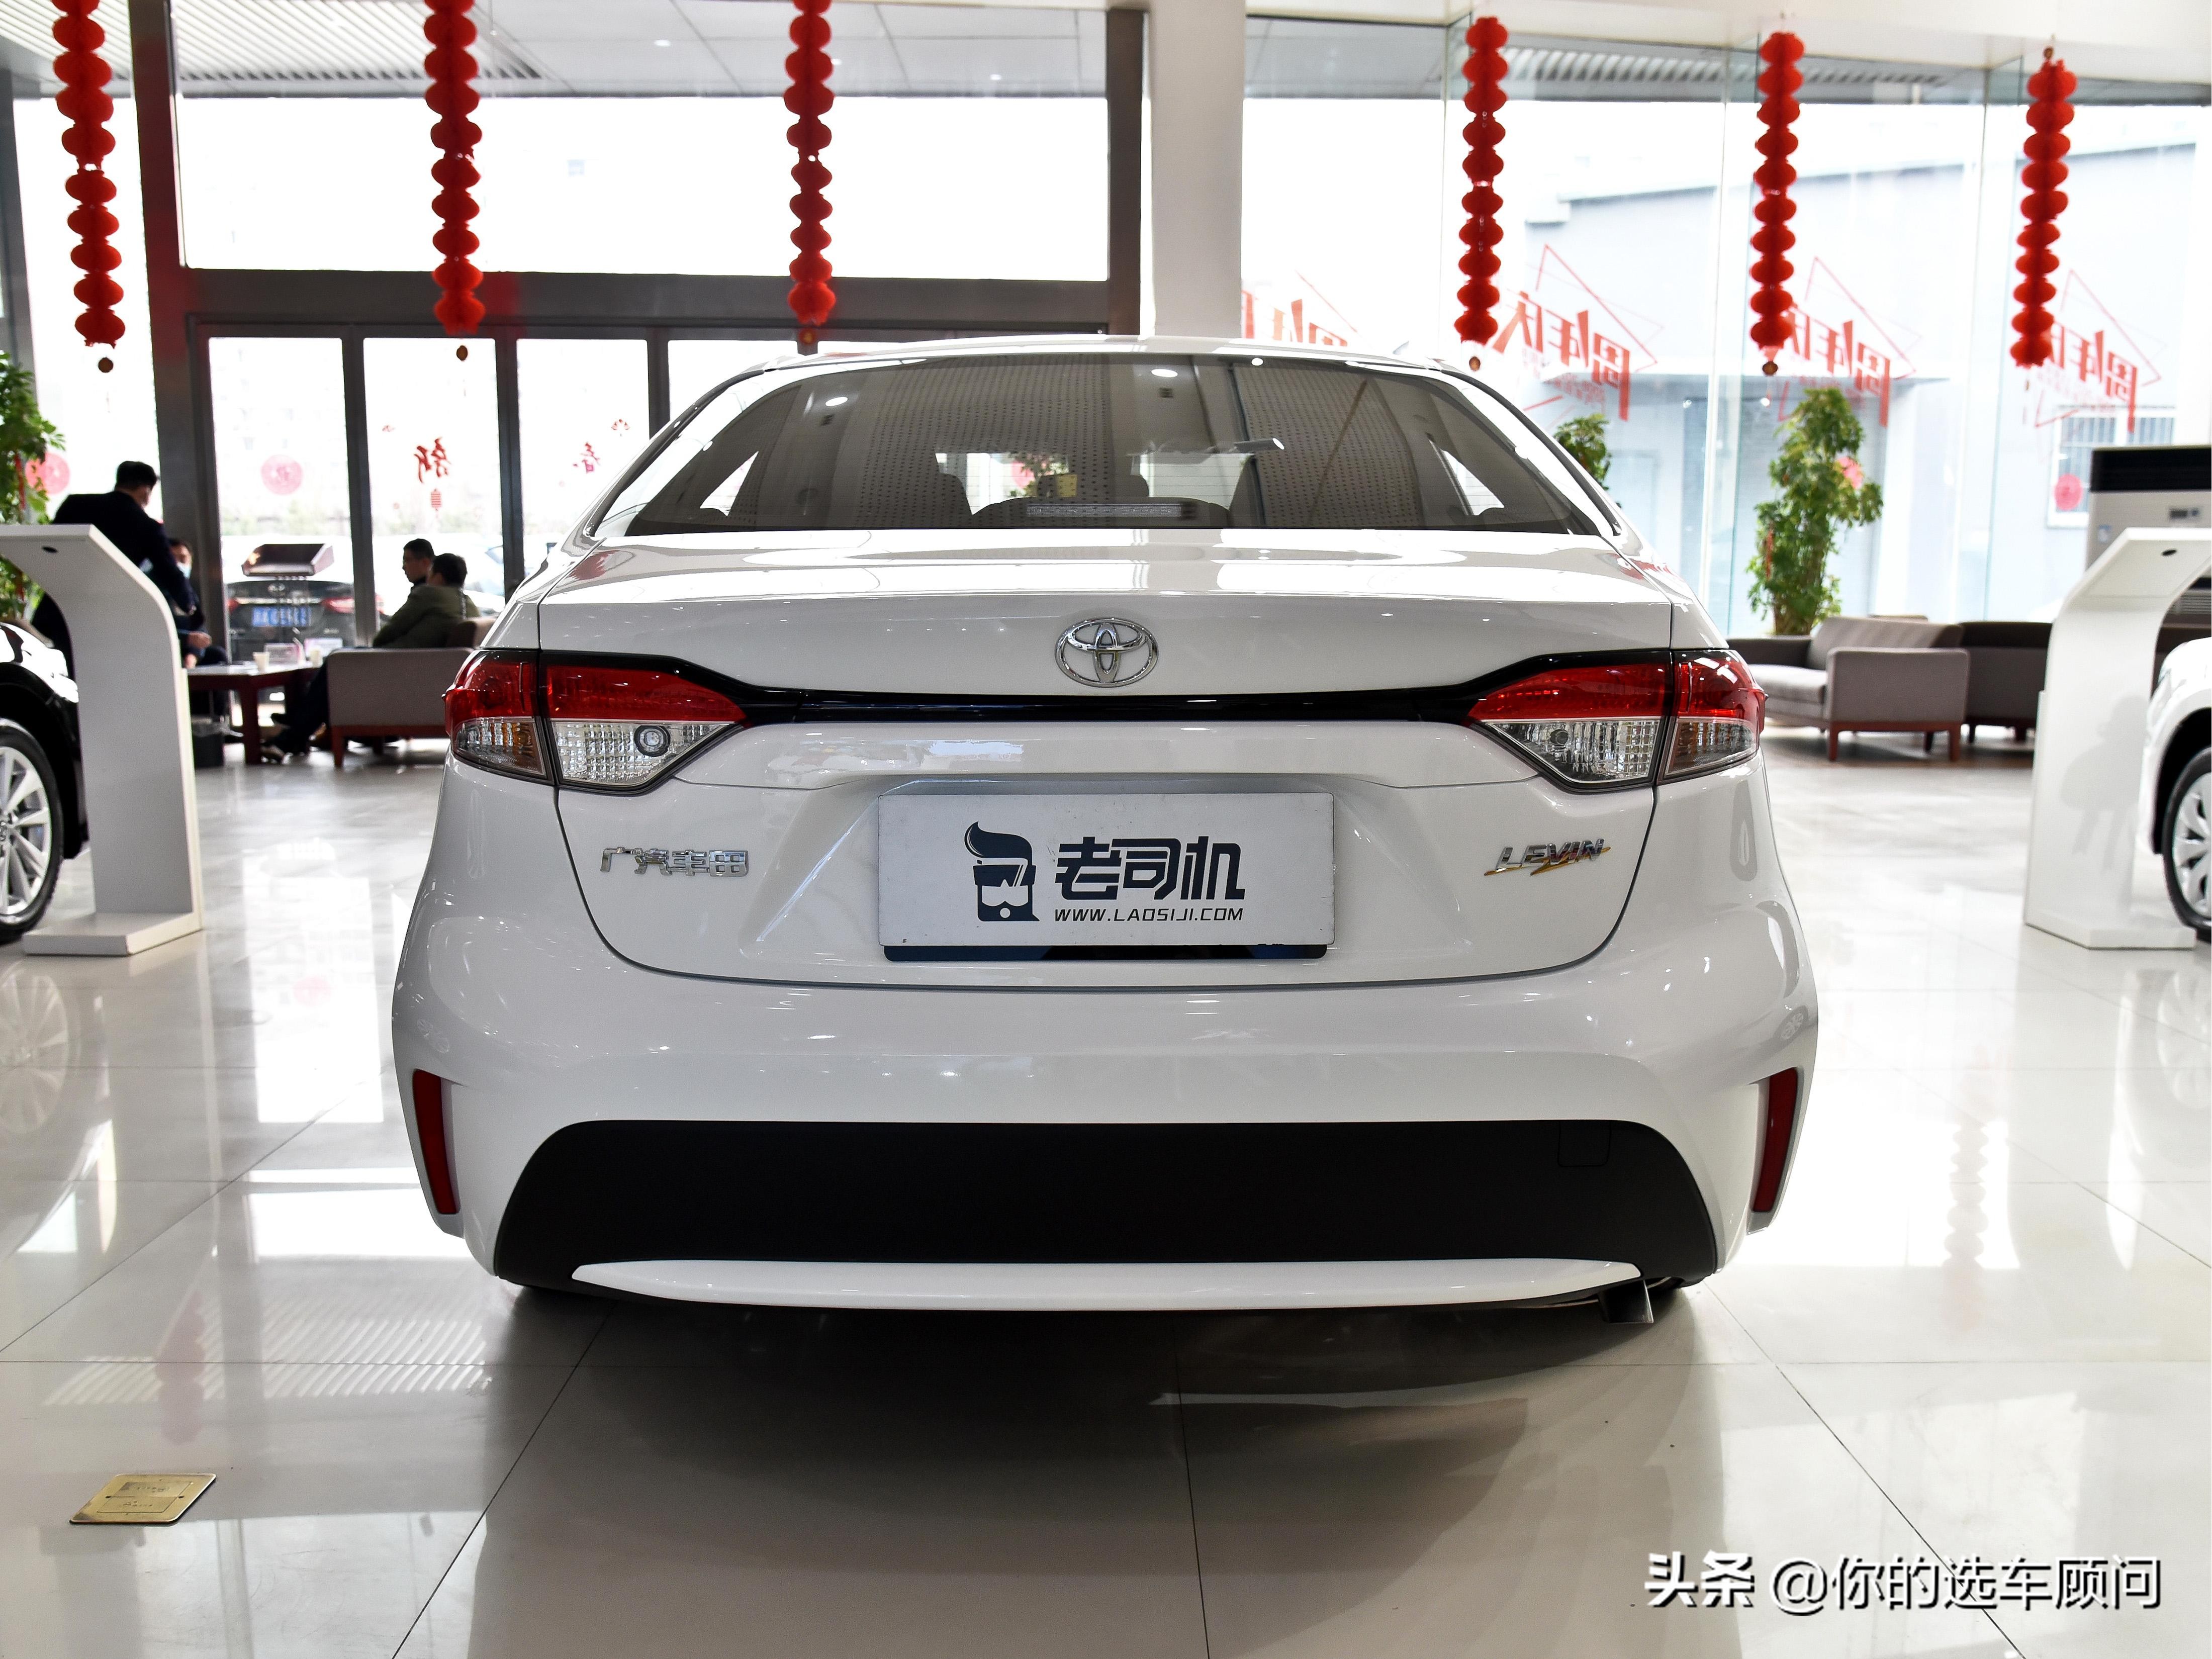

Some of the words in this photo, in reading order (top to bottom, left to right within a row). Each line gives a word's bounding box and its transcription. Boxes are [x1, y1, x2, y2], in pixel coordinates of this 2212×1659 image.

[600, 847, 749, 877] 广汽丰田
[1055, 836, 1246, 900] 老司机
[1495, 838, 1606, 870] LEVIN
[1055, 907, 1243, 921] WWW.LAOSIJI.COM
